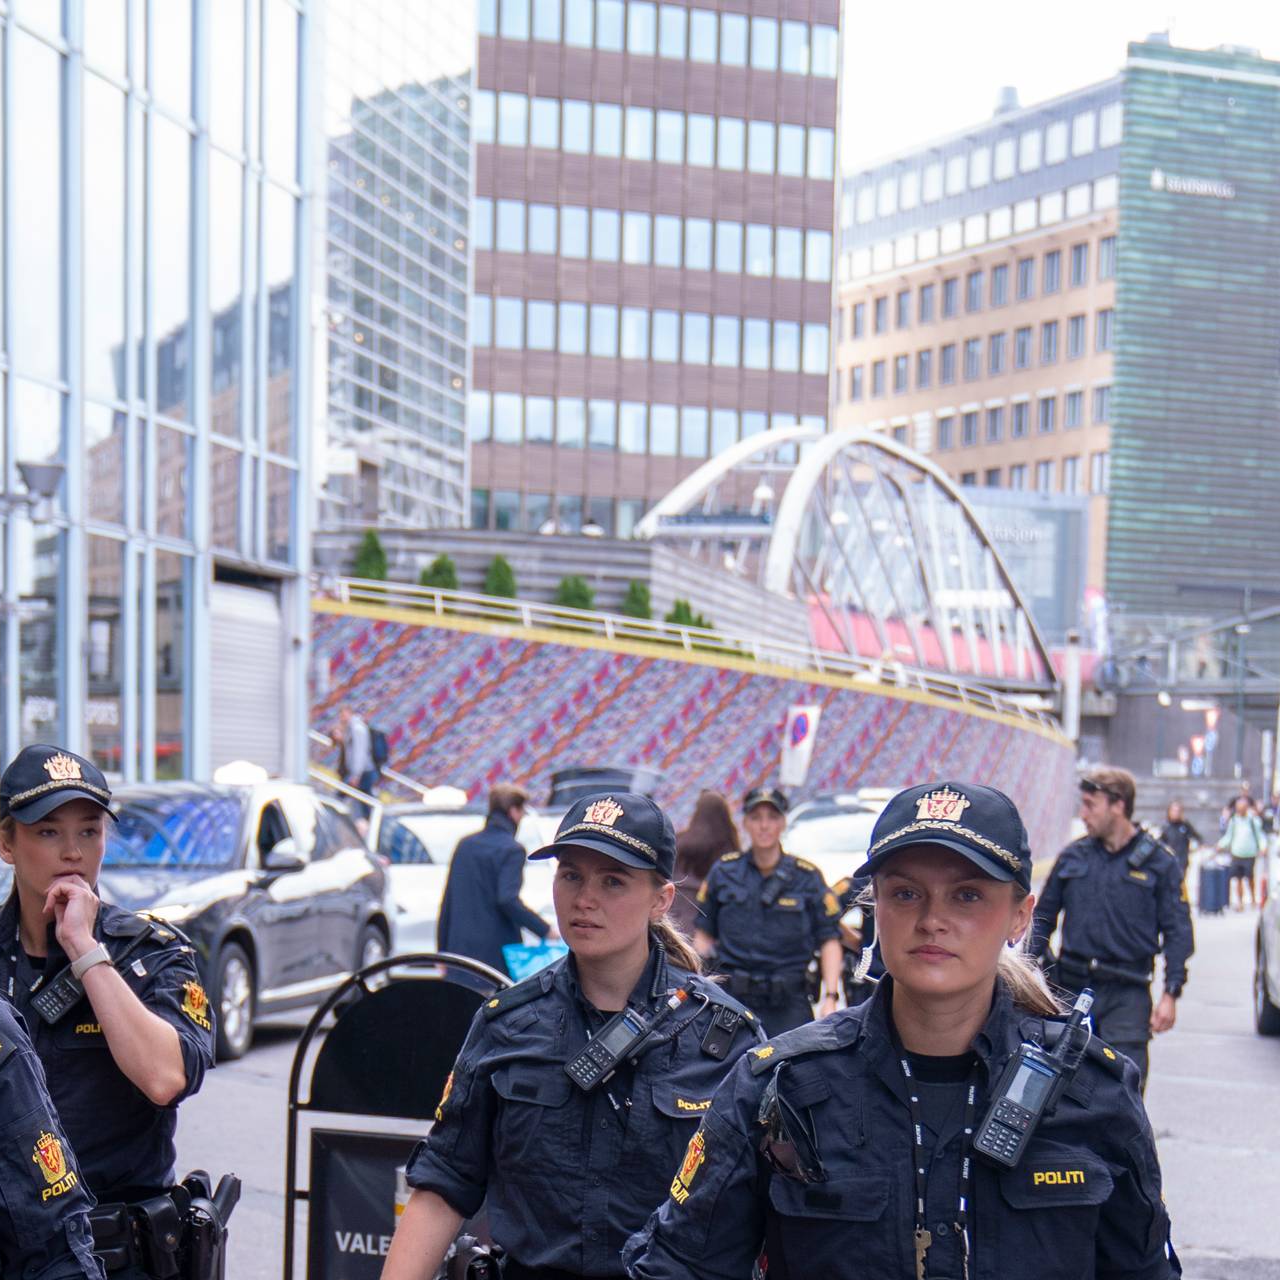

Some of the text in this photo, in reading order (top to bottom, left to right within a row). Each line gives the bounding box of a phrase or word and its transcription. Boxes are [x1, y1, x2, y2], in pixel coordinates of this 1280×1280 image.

[677, 1098, 712, 1112] POLIT
[42, 1171, 78, 1201] POLITI
[1033, 1170, 1085, 1185] POLITI
[335, 1231, 393, 1256] VALE
